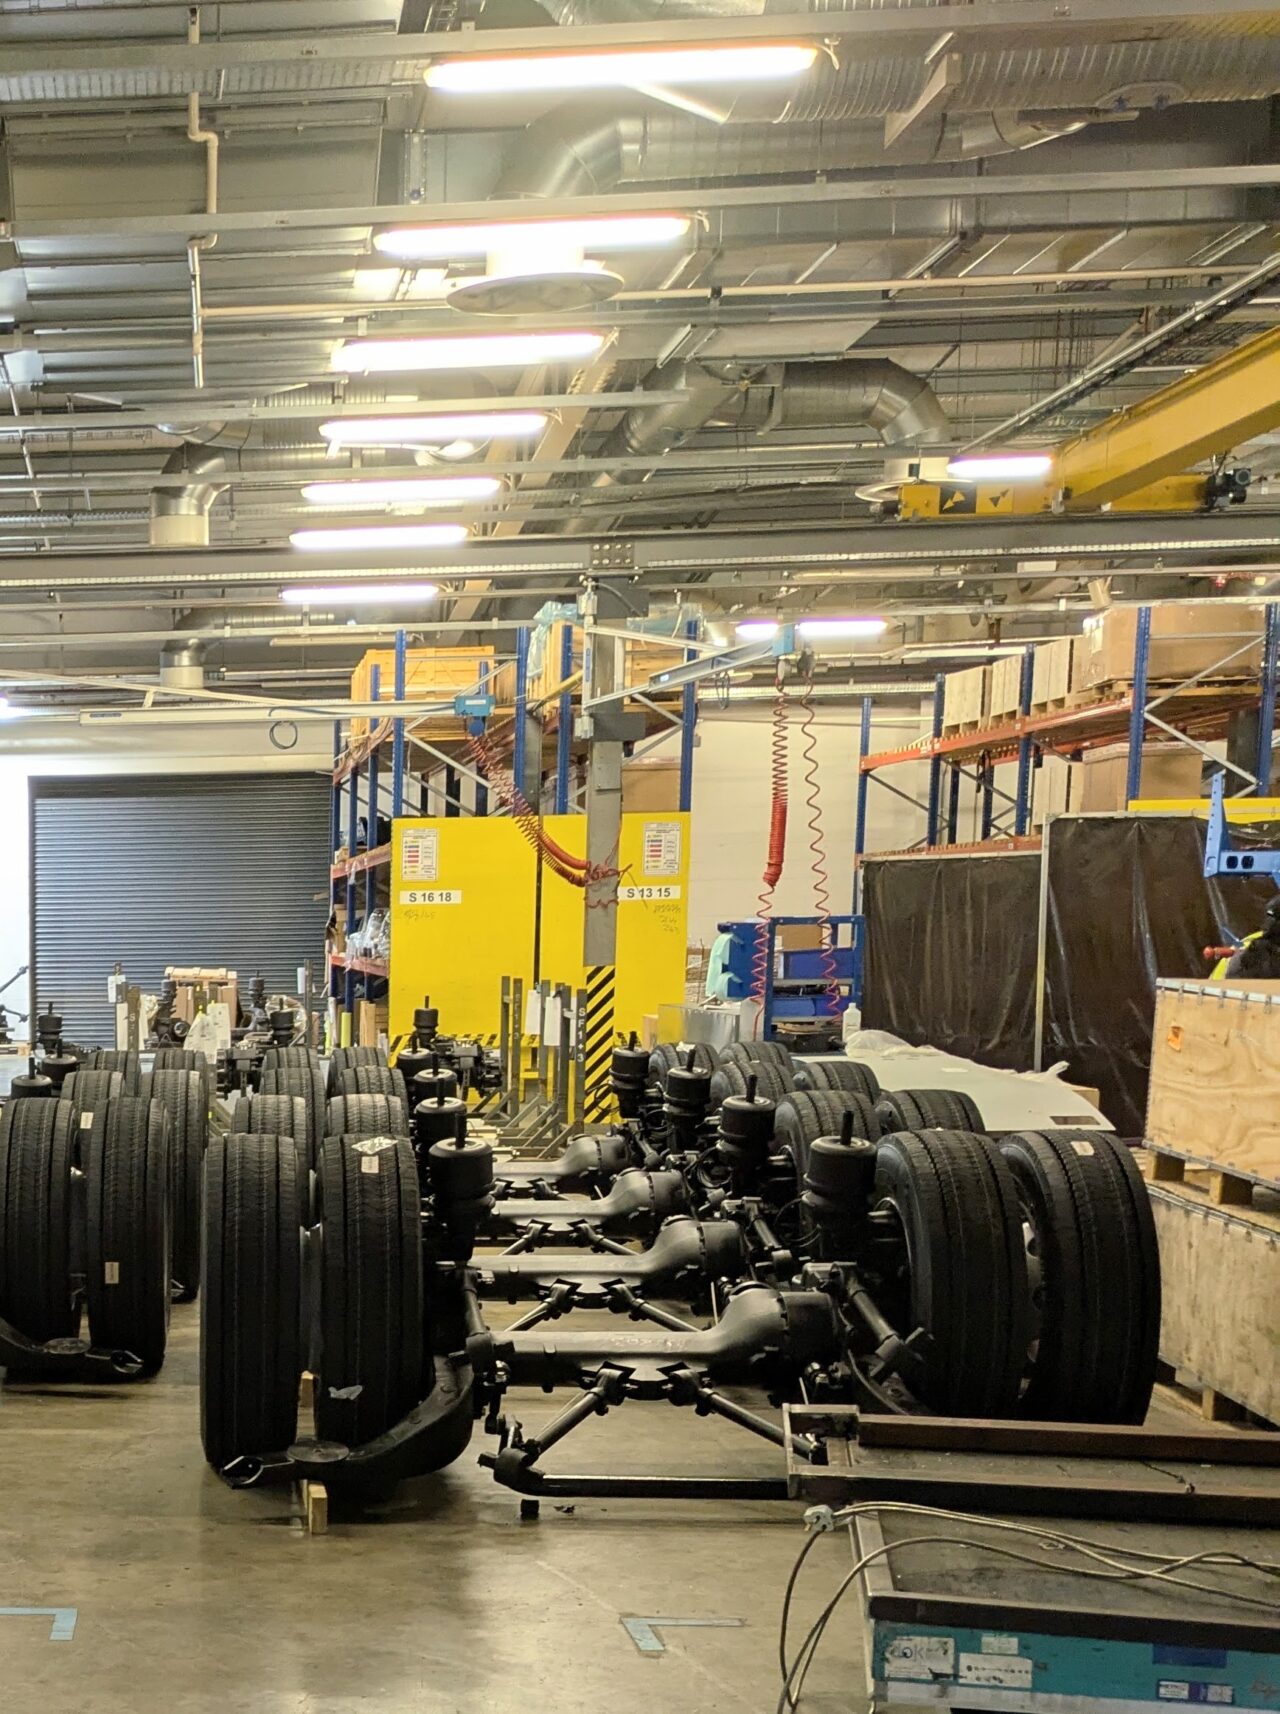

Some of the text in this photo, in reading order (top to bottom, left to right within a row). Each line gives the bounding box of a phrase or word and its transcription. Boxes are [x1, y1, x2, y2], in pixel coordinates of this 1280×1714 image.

[408, 892, 452, 902] S 16 18
[627, 887, 671, 899] S 13 15
[577, 1007, 586, 1062] SF1+3
